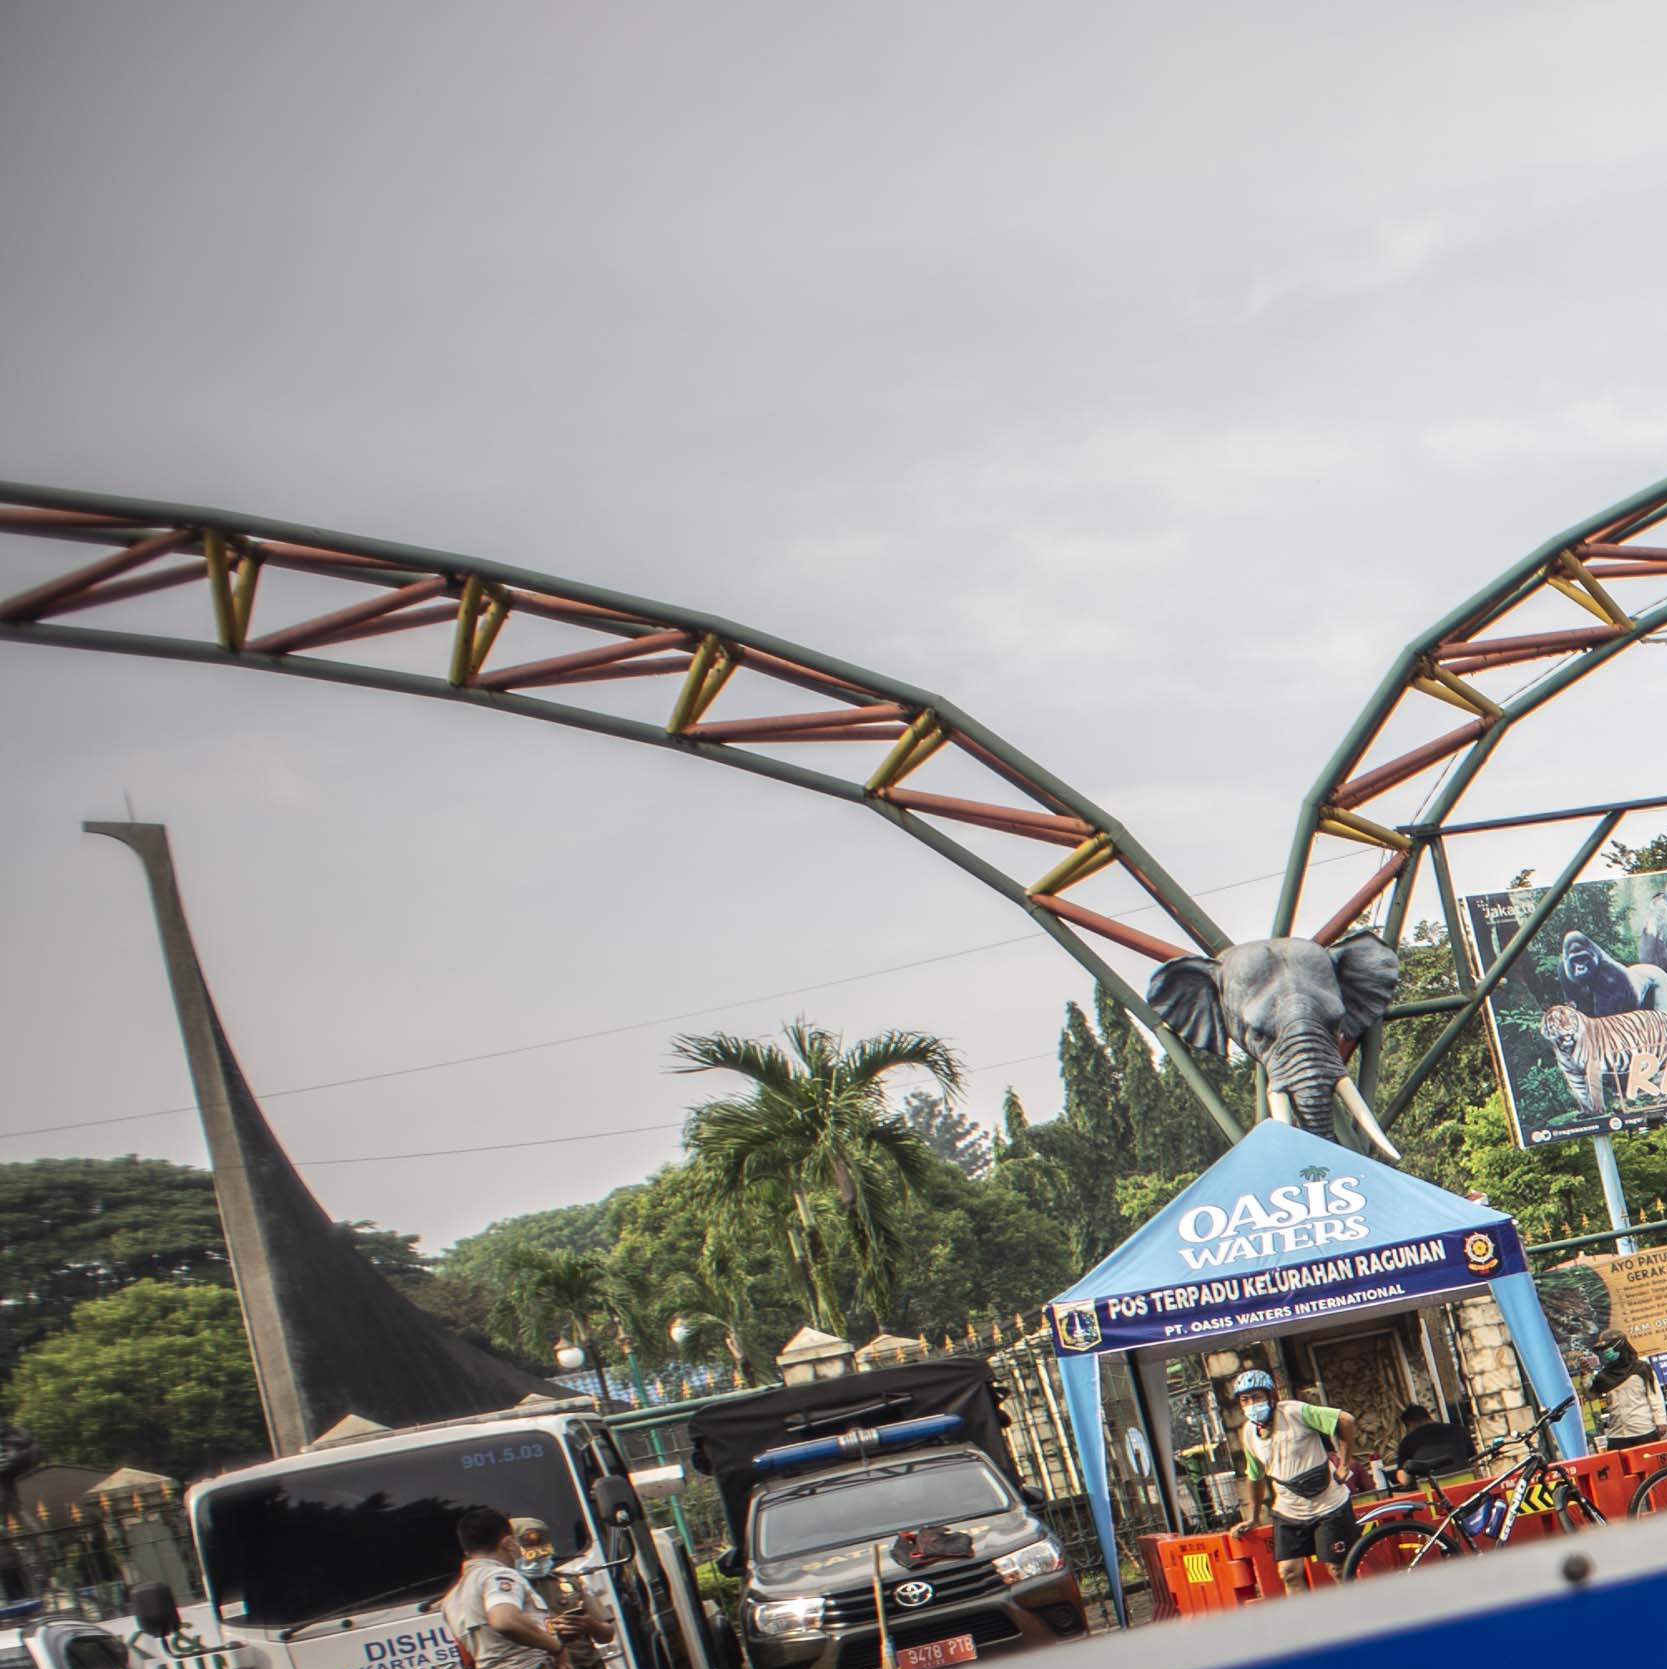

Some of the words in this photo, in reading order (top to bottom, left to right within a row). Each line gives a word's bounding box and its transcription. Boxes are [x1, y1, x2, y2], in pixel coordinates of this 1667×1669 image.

[1178, 1176, 1367, 1243] OASIS
[1179, 1215, 1370, 1271] WATERS
[1611, 1258, 1634, 1273] AYO
[1108, 1295, 1149, 1320] POS
[1150, 1276, 1240, 1314] TERPADU
[1242, 1258, 1353, 1298] KELURAHAN
[1356, 1240, 1446, 1275] RAGUNAN
[1164, 1322, 1188, 1338] PT.
[1190, 1316, 1233, 1334] OASIS
[1236, 1305, 1292, 1327] WATERS
[1295, 1284, 1406, 1316] INTERNATIONAL
[462, 1443, 545, 1470] 901.5.03
[364, 1626, 456, 1662] DISHU
